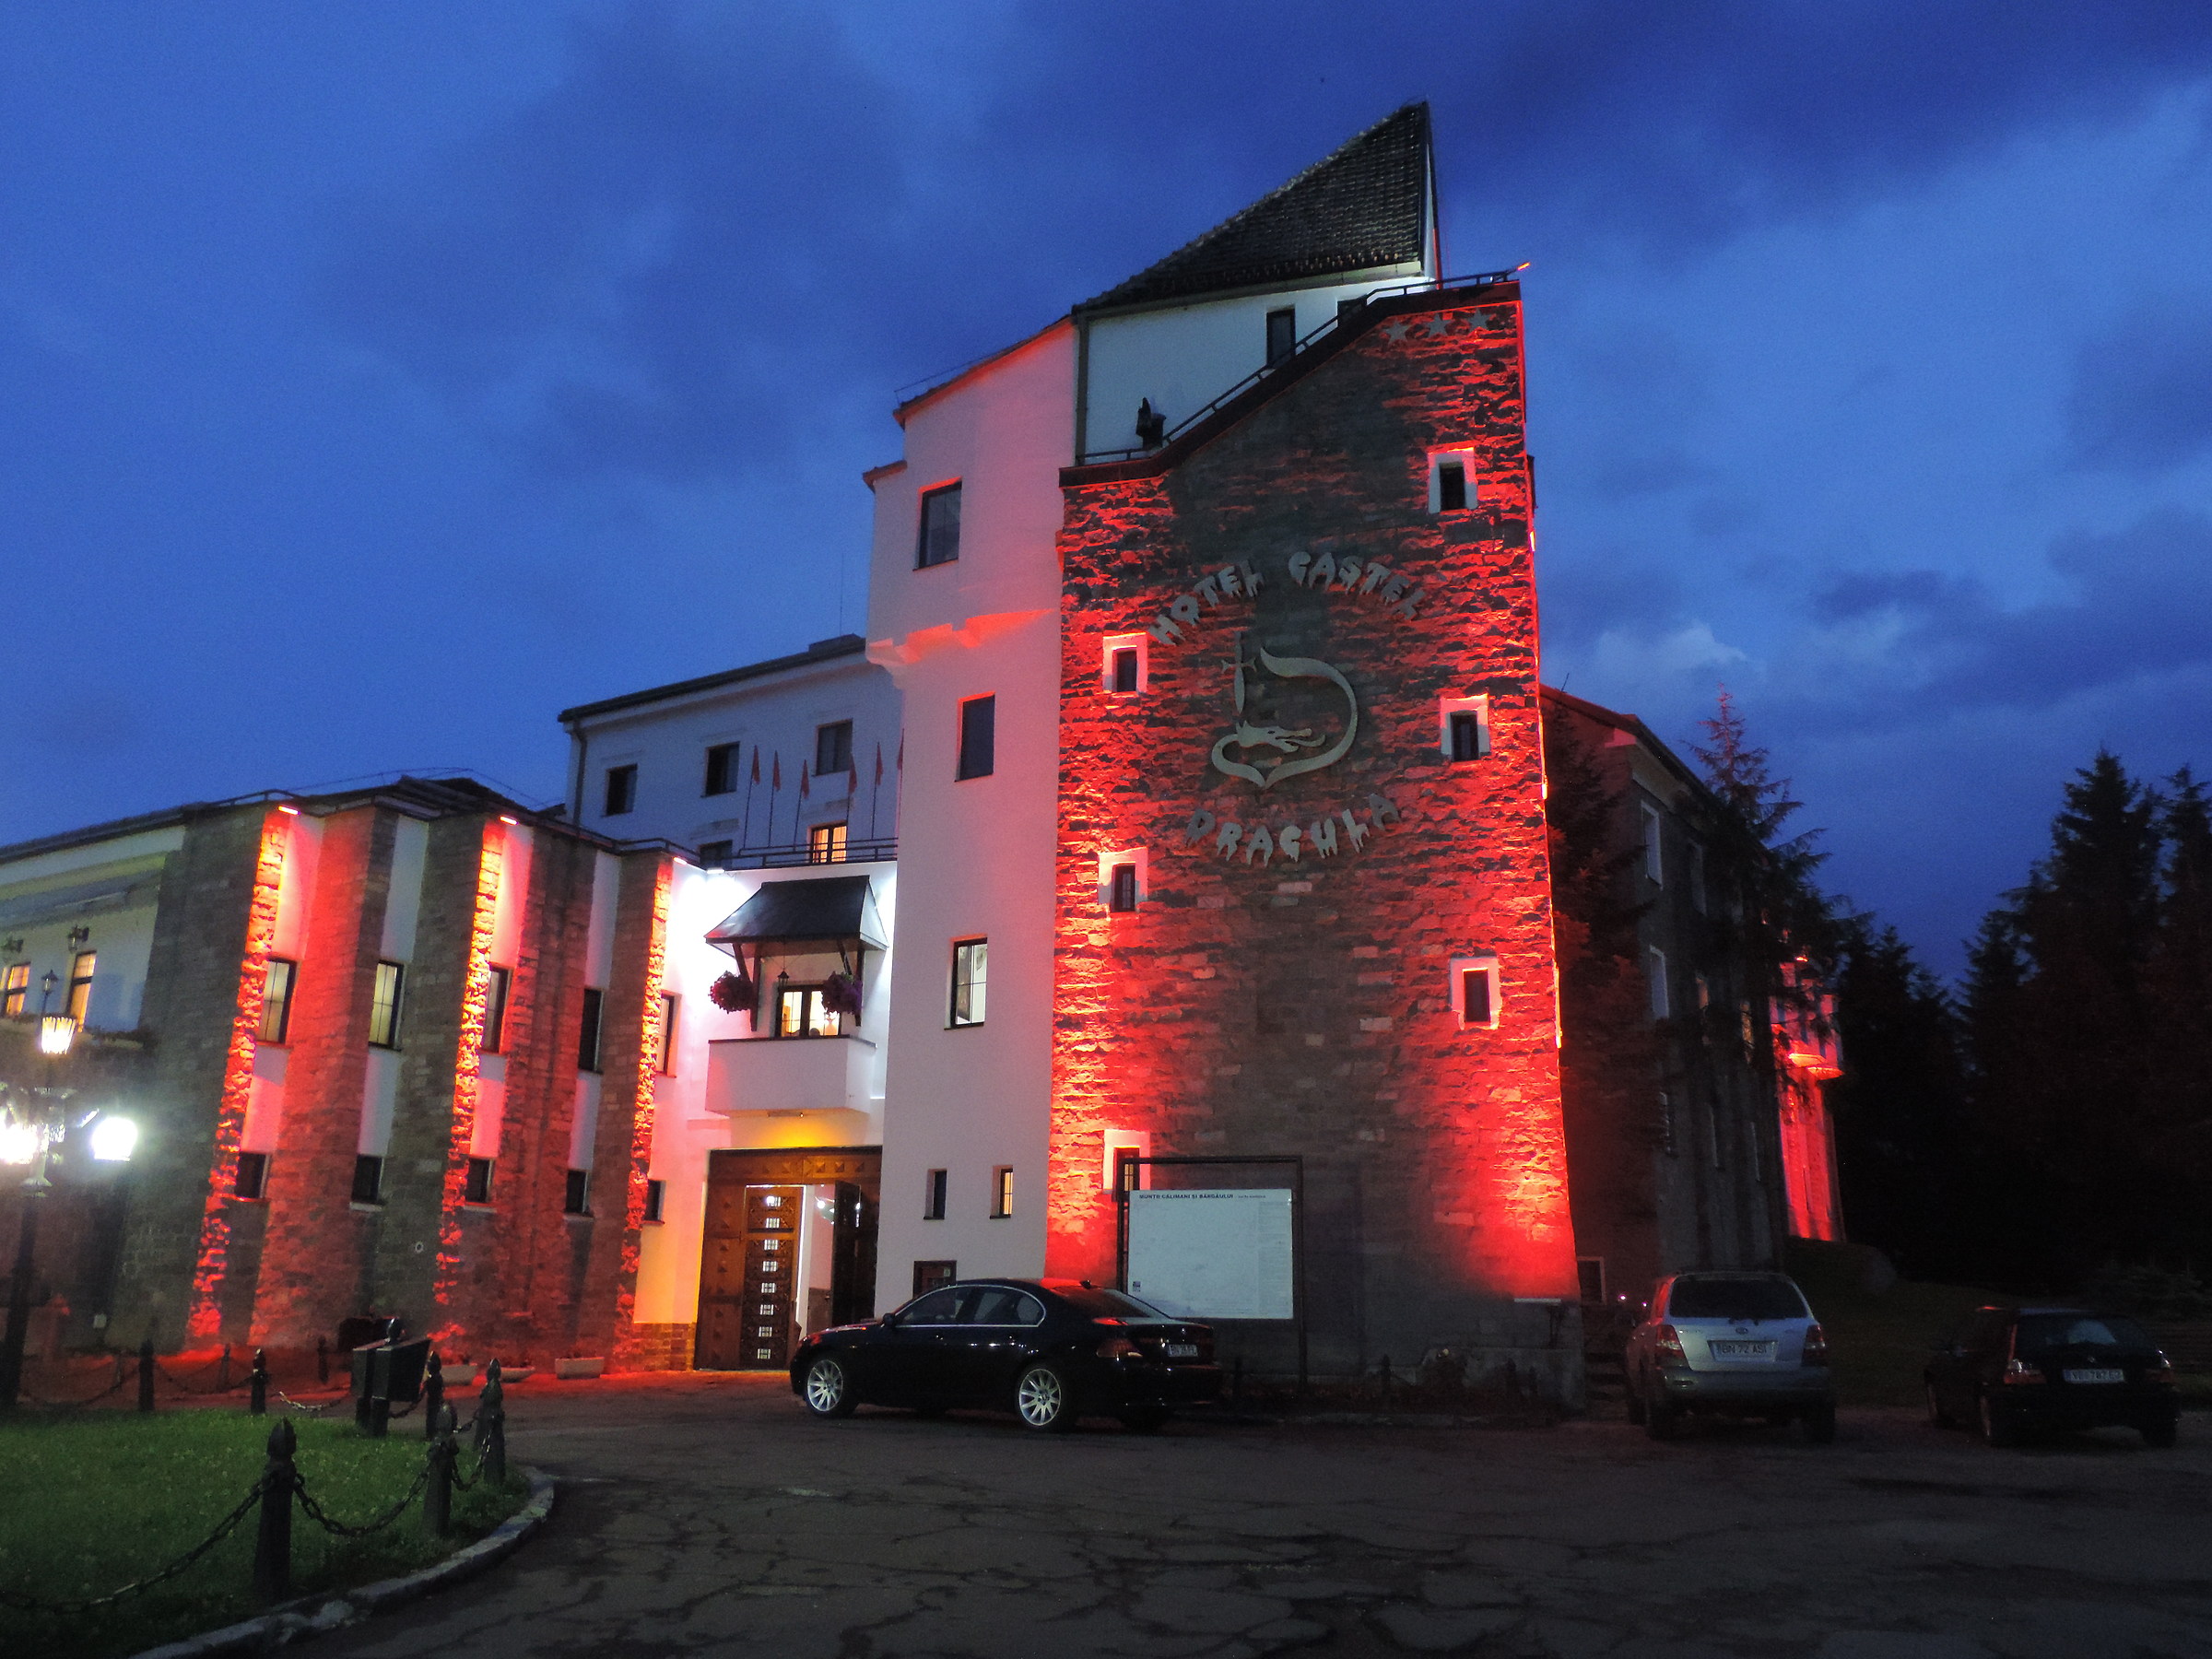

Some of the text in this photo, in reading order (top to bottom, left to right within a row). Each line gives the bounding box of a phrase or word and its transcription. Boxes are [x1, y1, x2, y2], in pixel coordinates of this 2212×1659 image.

[1148, 551, 1426, 646] HOTEL CASTEL
[1183, 793, 1402, 868] DRACULA
